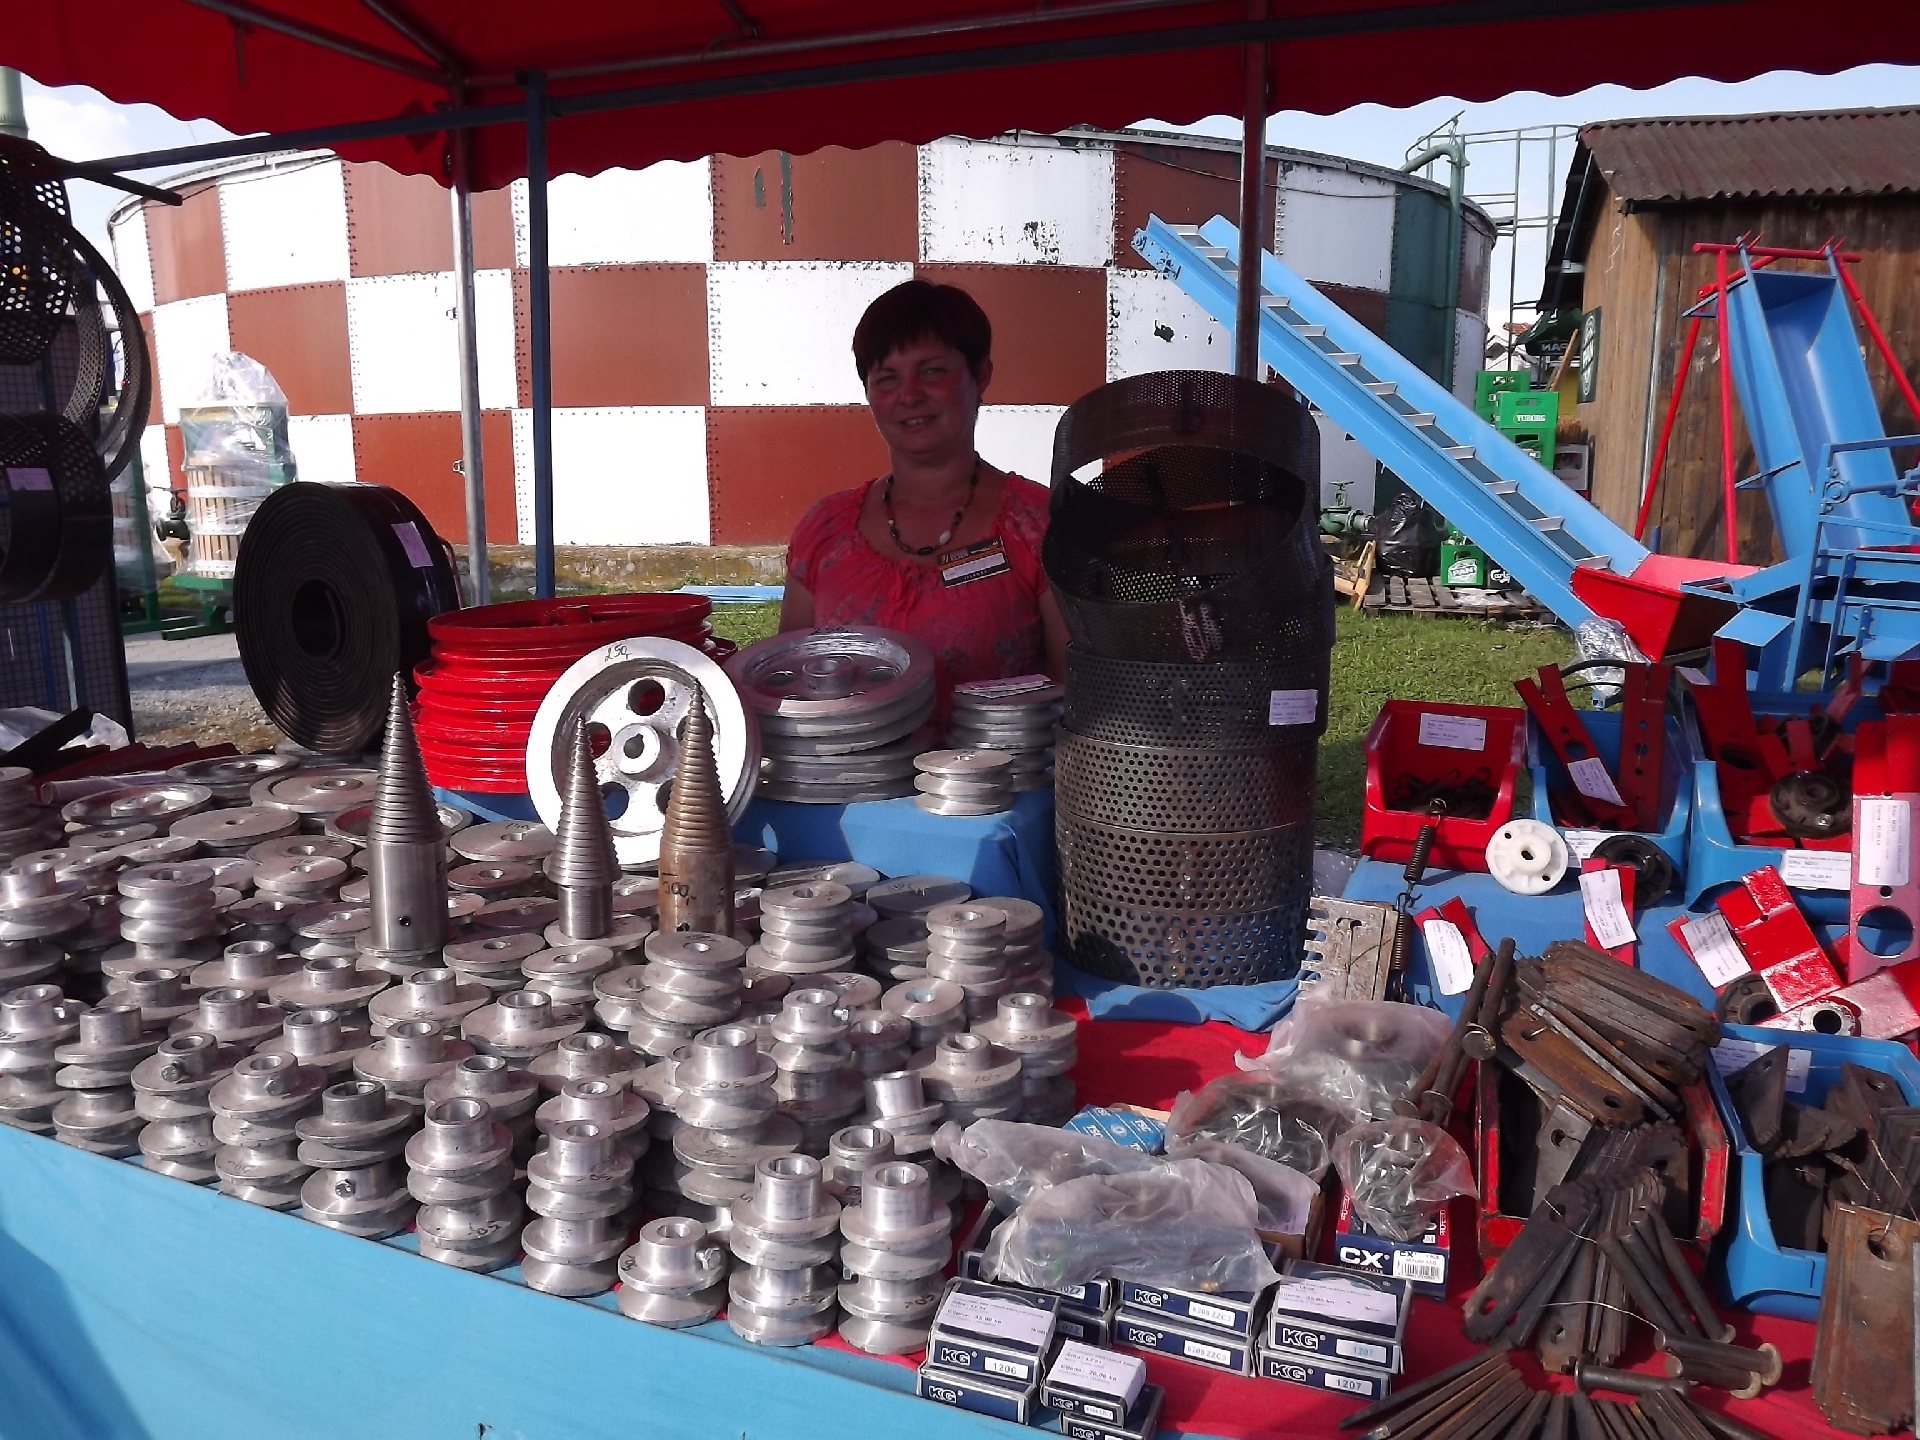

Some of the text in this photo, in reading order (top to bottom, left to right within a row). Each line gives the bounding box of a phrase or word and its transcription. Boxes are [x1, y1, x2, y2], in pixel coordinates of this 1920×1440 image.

[1452, 566, 1475, 576] PAN
[1490, 569, 1510, 584] Carls
[1340, 1246, 1383, 1269] CX
[1135, 1289, 1162, 1307] KG
[1129, 1328, 1157, 1346] KG
[1282, 1328, 1374, 1357] KG 1207
[941, 1348, 1017, 1375] KG 1206
[1271, 1361, 1362, 1391] KG 1207
[929, 1385, 956, 1403] KG
[1052, 1396, 1074, 1411] KG
[1072, 1426, 1095, 1440] KG
